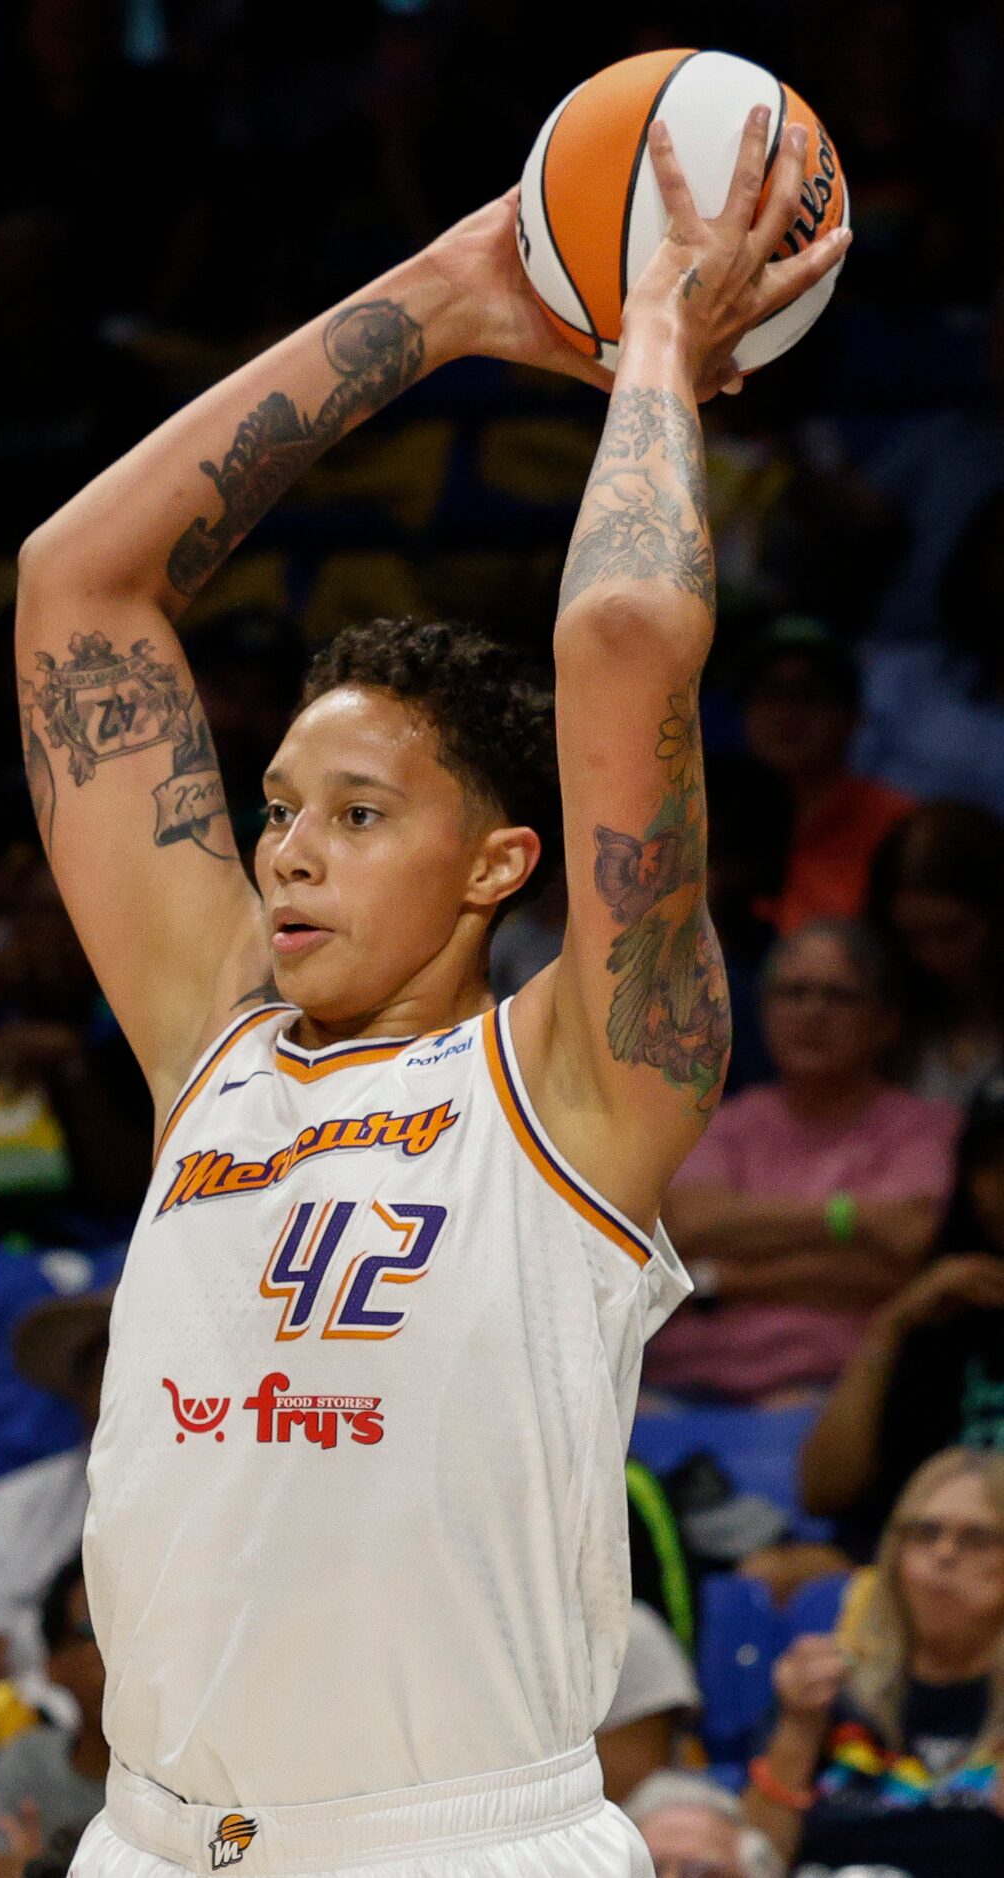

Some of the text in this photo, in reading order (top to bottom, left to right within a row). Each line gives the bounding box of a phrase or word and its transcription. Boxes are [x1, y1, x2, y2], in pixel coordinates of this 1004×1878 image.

[406, 1036, 473, 1067] PayPal
[153, 1099, 460, 1222] Mercury
[260, 1198, 448, 1342] 42
[243, 1372, 384, 1450] fry's
[276, 1397, 374, 1409] FOOD STORES
